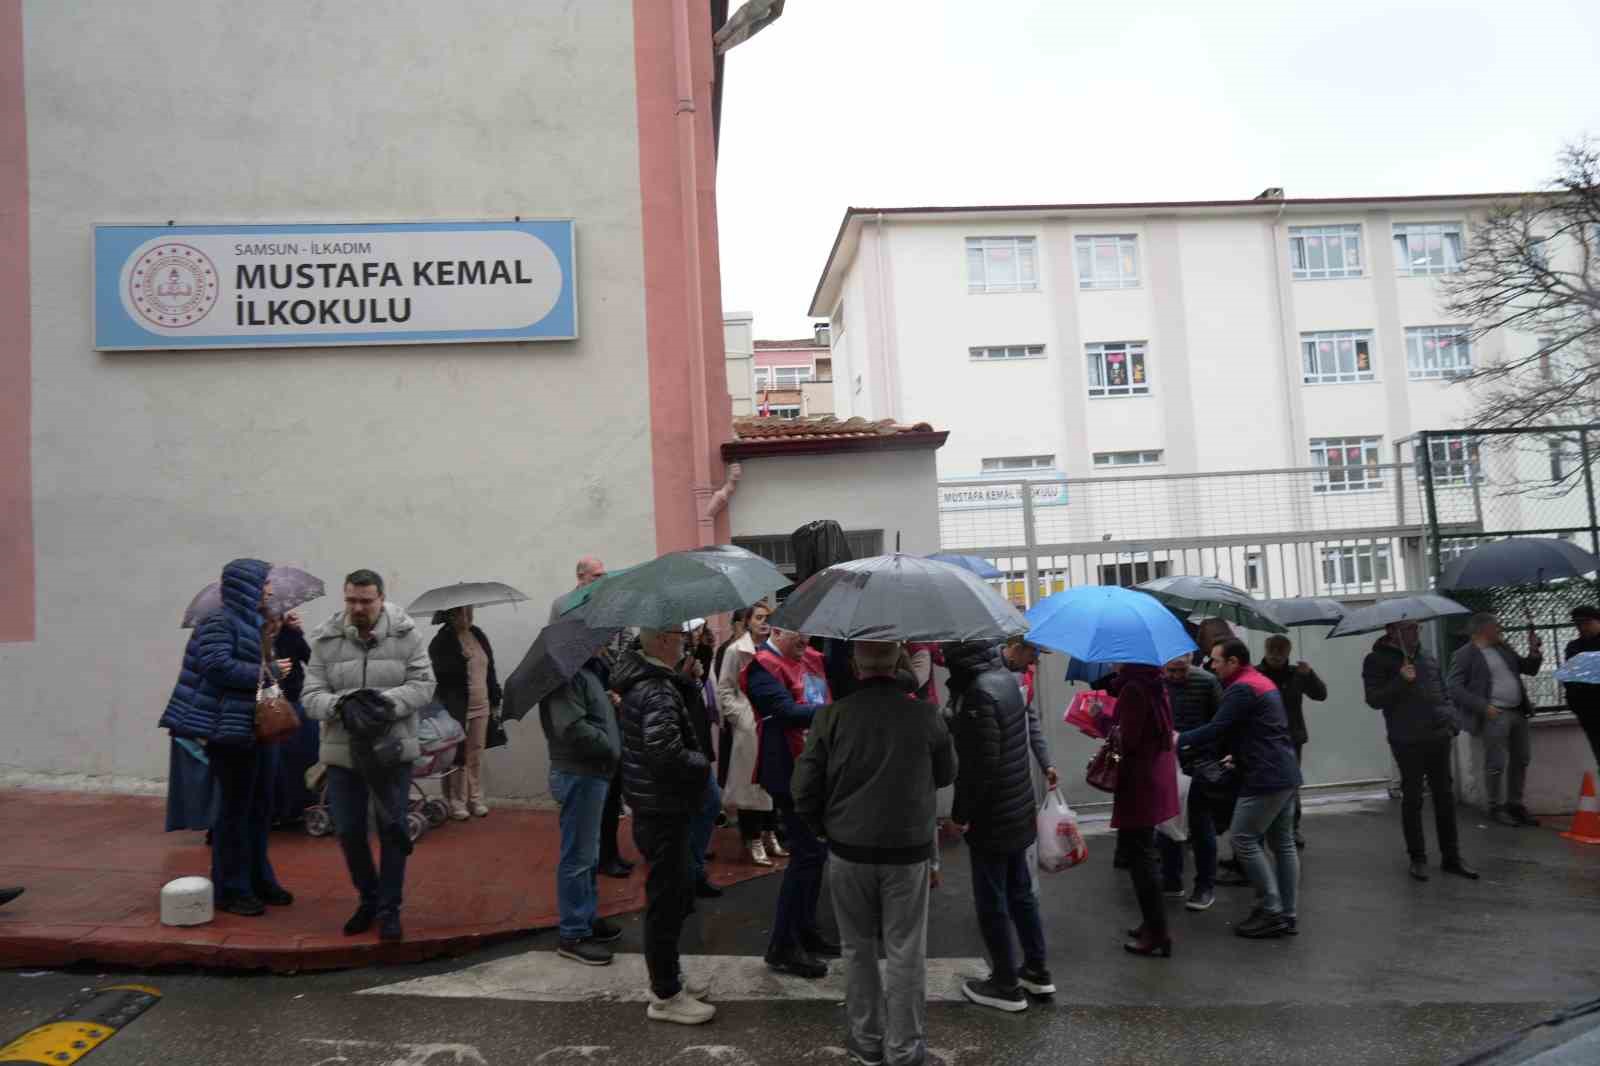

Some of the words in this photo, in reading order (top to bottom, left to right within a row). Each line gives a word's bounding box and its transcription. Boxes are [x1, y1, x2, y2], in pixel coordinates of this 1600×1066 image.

[235, 243, 299, 256] SAMSUN
[311, 240, 371, 255] İLKADIM
[235, 262, 403, 289] MUSTAFA
[413, 259, 533, 286] KEMAL
[236, 294, 411, 325] İLKOKULU
[944, 490, 983, 503] MUSTAFA
